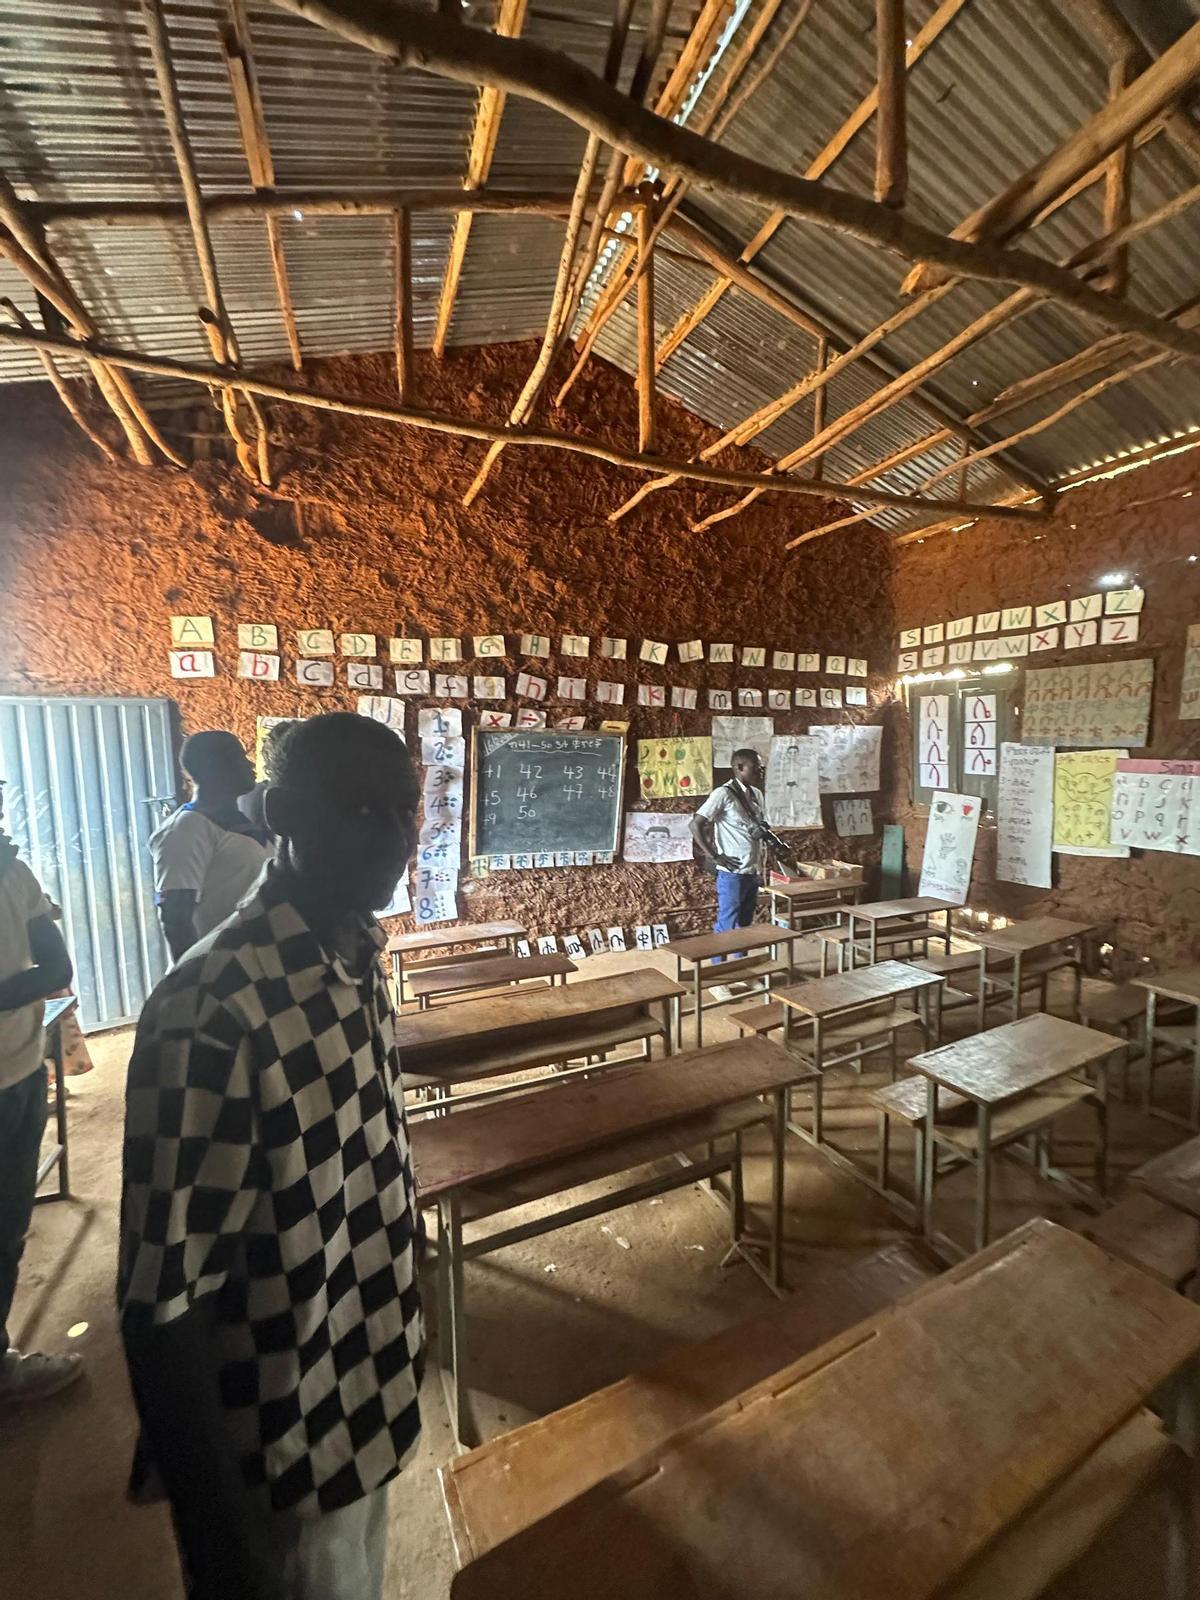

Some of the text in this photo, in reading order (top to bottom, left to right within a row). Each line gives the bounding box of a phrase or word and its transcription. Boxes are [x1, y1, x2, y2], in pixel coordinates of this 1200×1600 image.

[907, 592, 1132, 644] S T U V W X Y Z
[179, 618, 866, 675] A B C D E F G H I J K L M N O P Q R
[930, 650, 940, 664] t
[180, 655, 200, 672] a
[252, 654, 269, 676] b
[355, 666, 371, 687] d
[405, 672, 420, 690] e
[443, 676, 456, 697] f
[526, 677, 541, 698] h
[714, 693, 727, 707] m
[743, 691, 756, 705] n
[826, 690, 836, 704] q
[433, 711, 446, 733] 1
[434, 741, 445, 760] 2
[433, 770, 444, 787] 3
[520, 761, 542, 779] 42
[563, 765, 583, 779] 43
[1139, 777, 1150, 788] b
[1181, 778, 1193, 790] d
[517, 785, 537, 802] 46
[563, 784, 583, 801] 47
[430, 799, 444, 814] 4
[517, 805, 536, 820] 50
[1155, 812, 1164, 827] q
[430, 823, 442, 840] 5
[423, 846, 434, 860] 6
[421, 871, 432, 889] 7
[420, 897, 433, 919] 8
